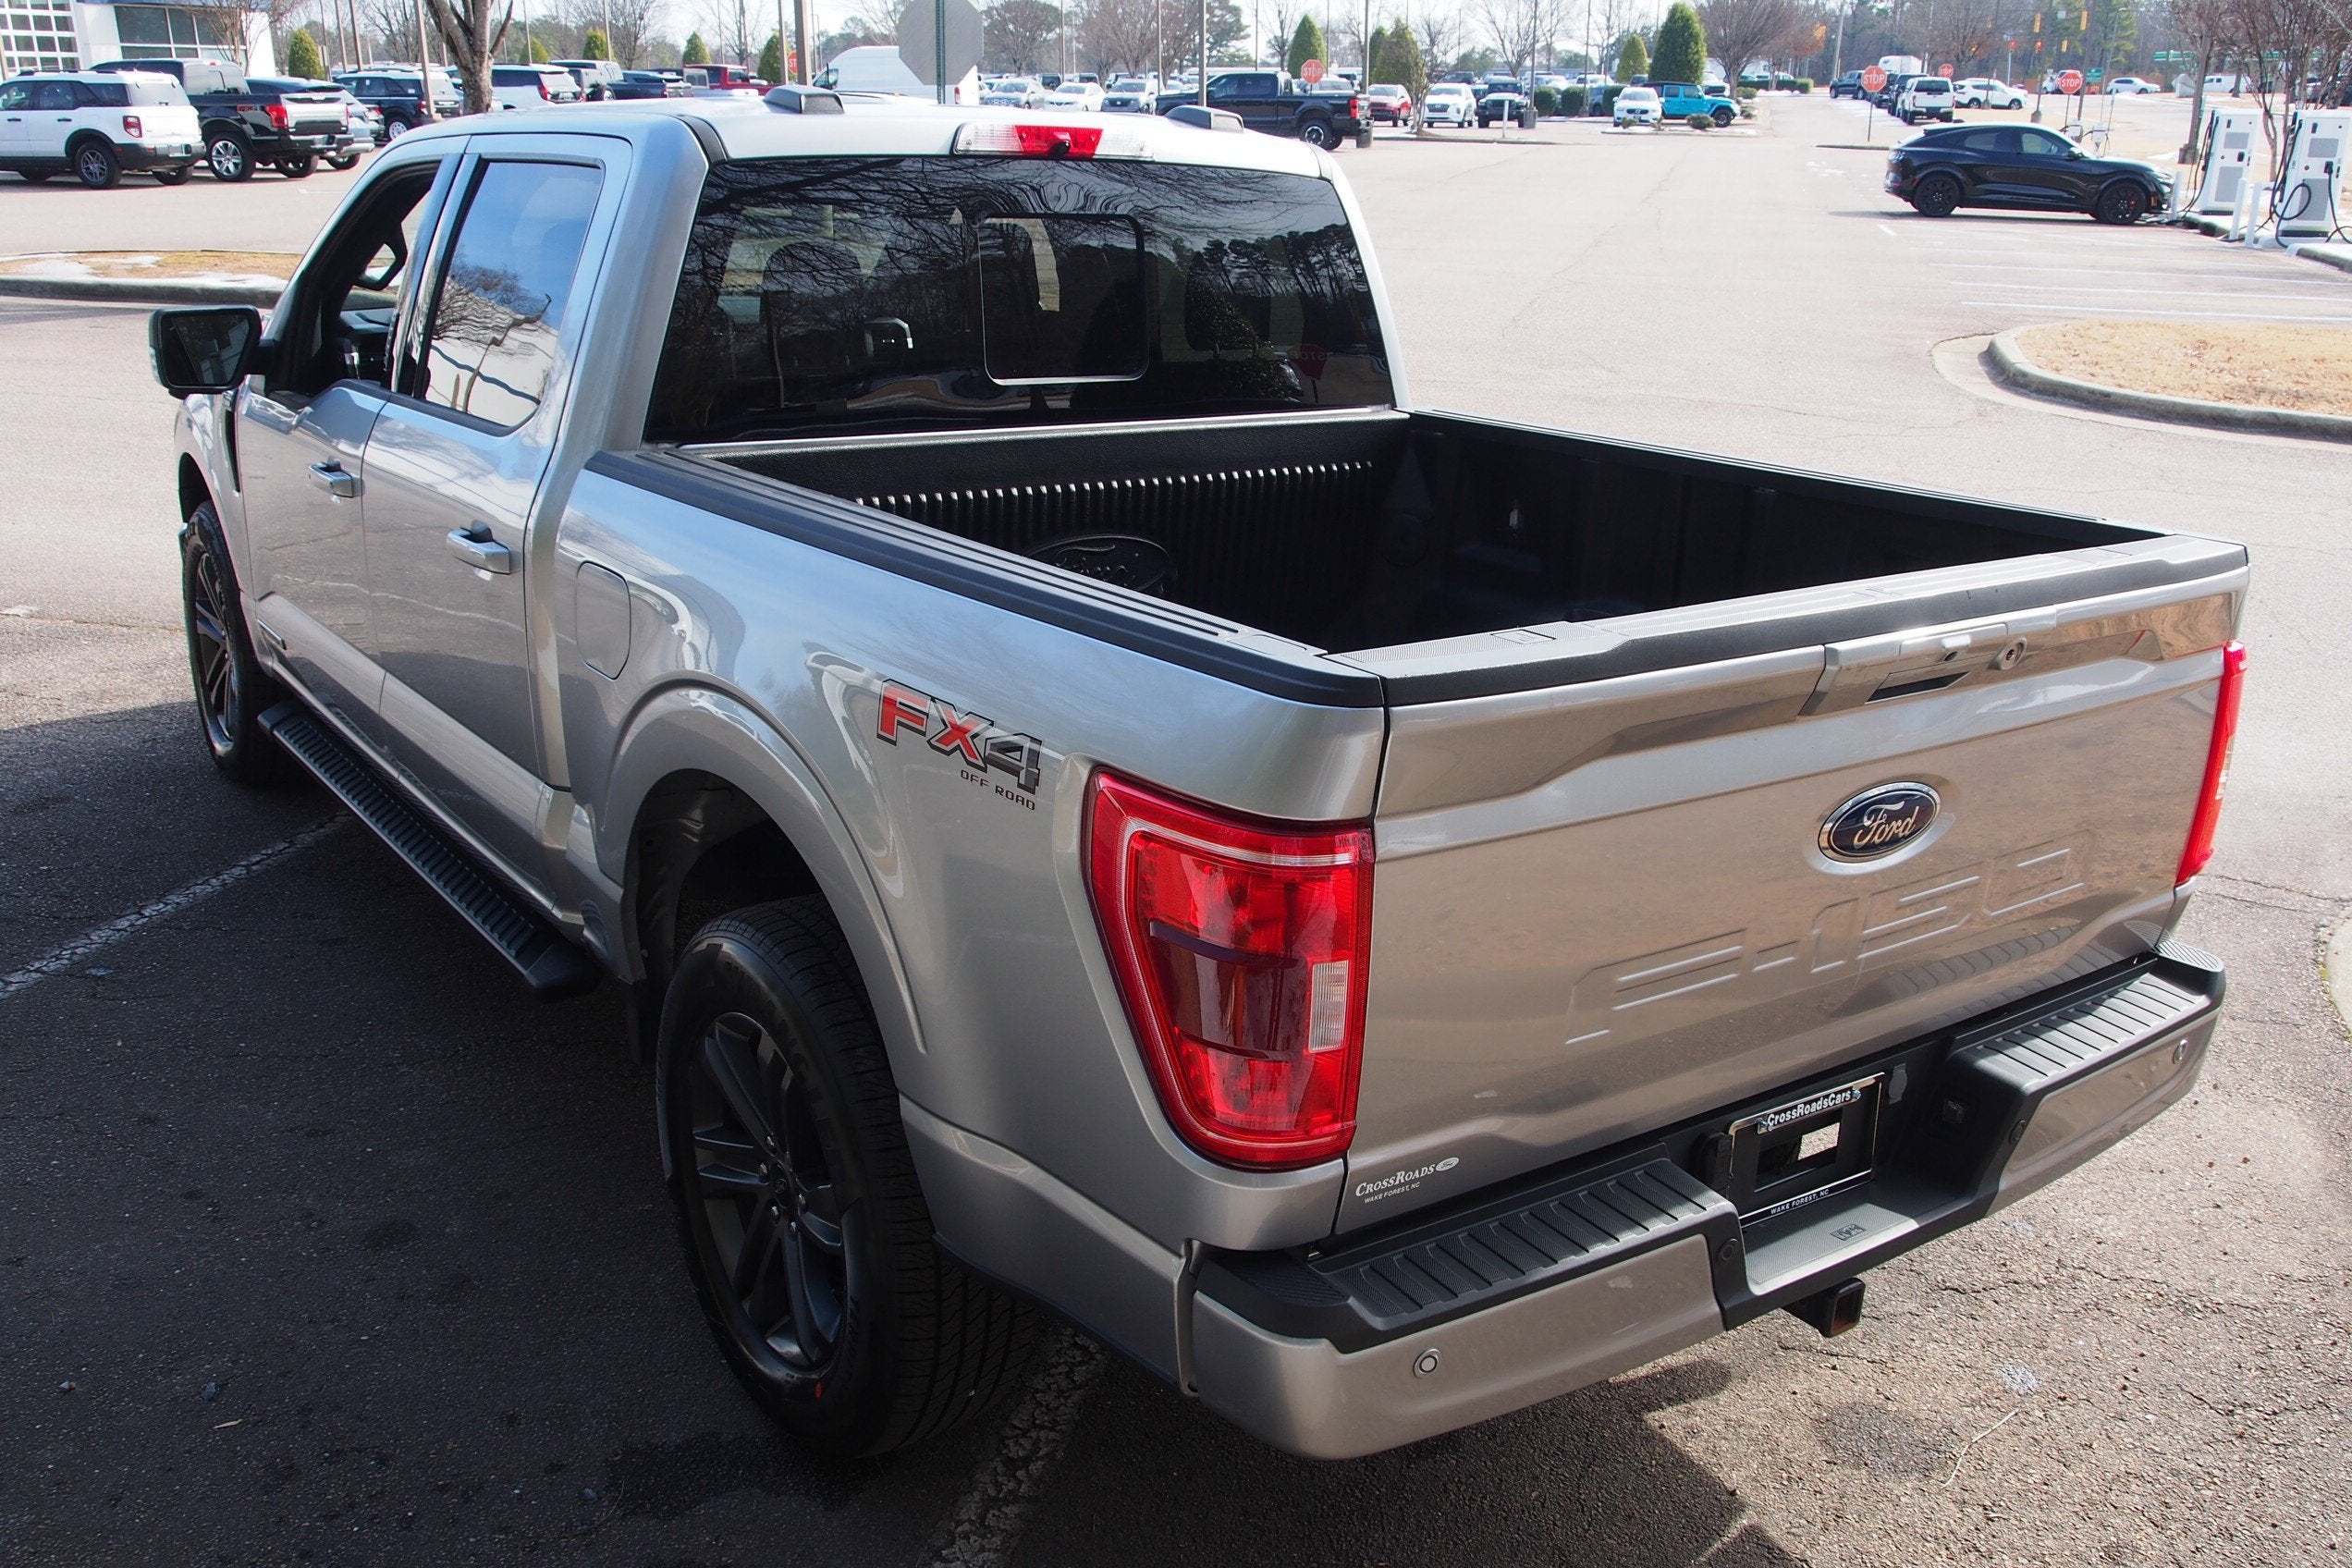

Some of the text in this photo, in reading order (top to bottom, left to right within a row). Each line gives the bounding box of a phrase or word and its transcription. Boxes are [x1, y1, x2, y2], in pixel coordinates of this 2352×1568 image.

[1303, 67, 1323, 77] STOP
[1864, 74, 1885, 84] STOP
[2062, 78, 2080, 88] STOP
[876, 679, 1043, 795] FX4
[961, 768, 1035, 811] OFF ROAD
[1853, 801, 1920, 849] Ford
[1566, 829, 2097, 1045] F-150
[1767, 1089, 1852, 1126] CrossRoadsCars
[1364, 1182, 1421, 1204] WAKE FOREST, NC
[1770, 1188, 1830, 1215] WAKE FOREST, NC
